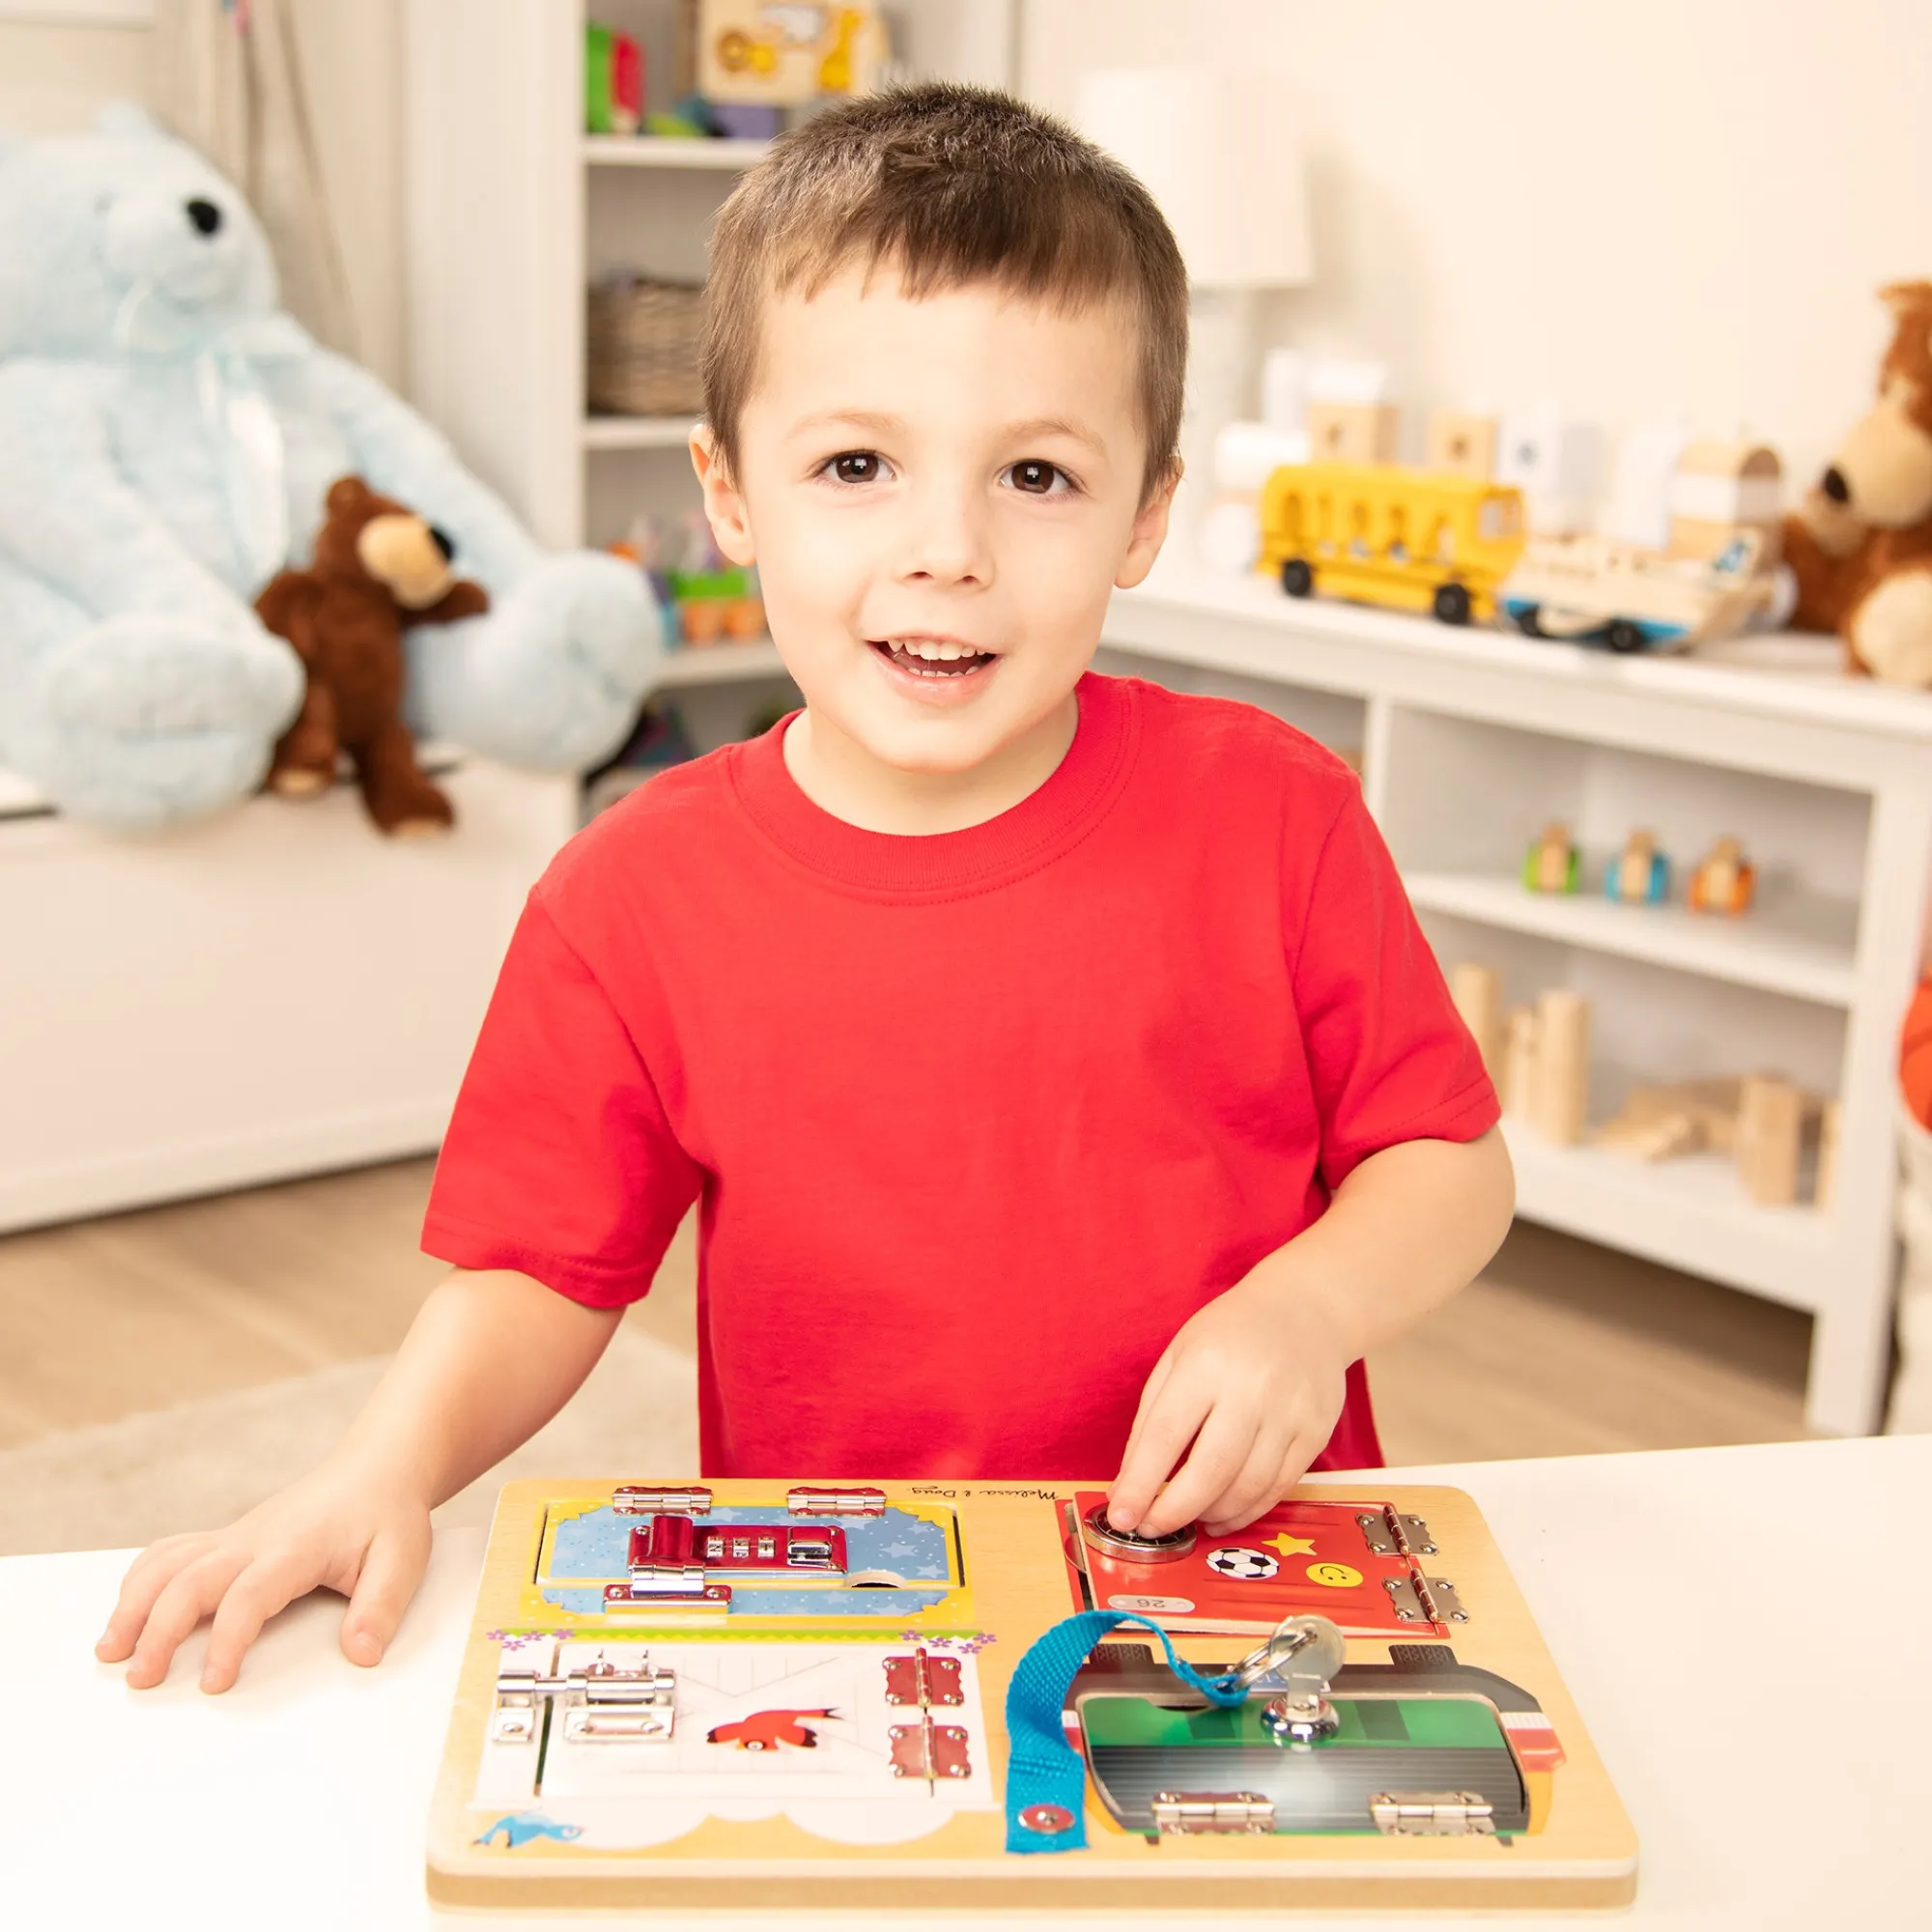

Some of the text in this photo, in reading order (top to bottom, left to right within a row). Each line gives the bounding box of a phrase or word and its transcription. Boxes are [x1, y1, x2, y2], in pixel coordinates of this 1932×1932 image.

[912, 1486, 956, 1498] Doug
[980, 1489, 1058, 1500] Melissa
[1136, 1598, 1166, 1608] 26
